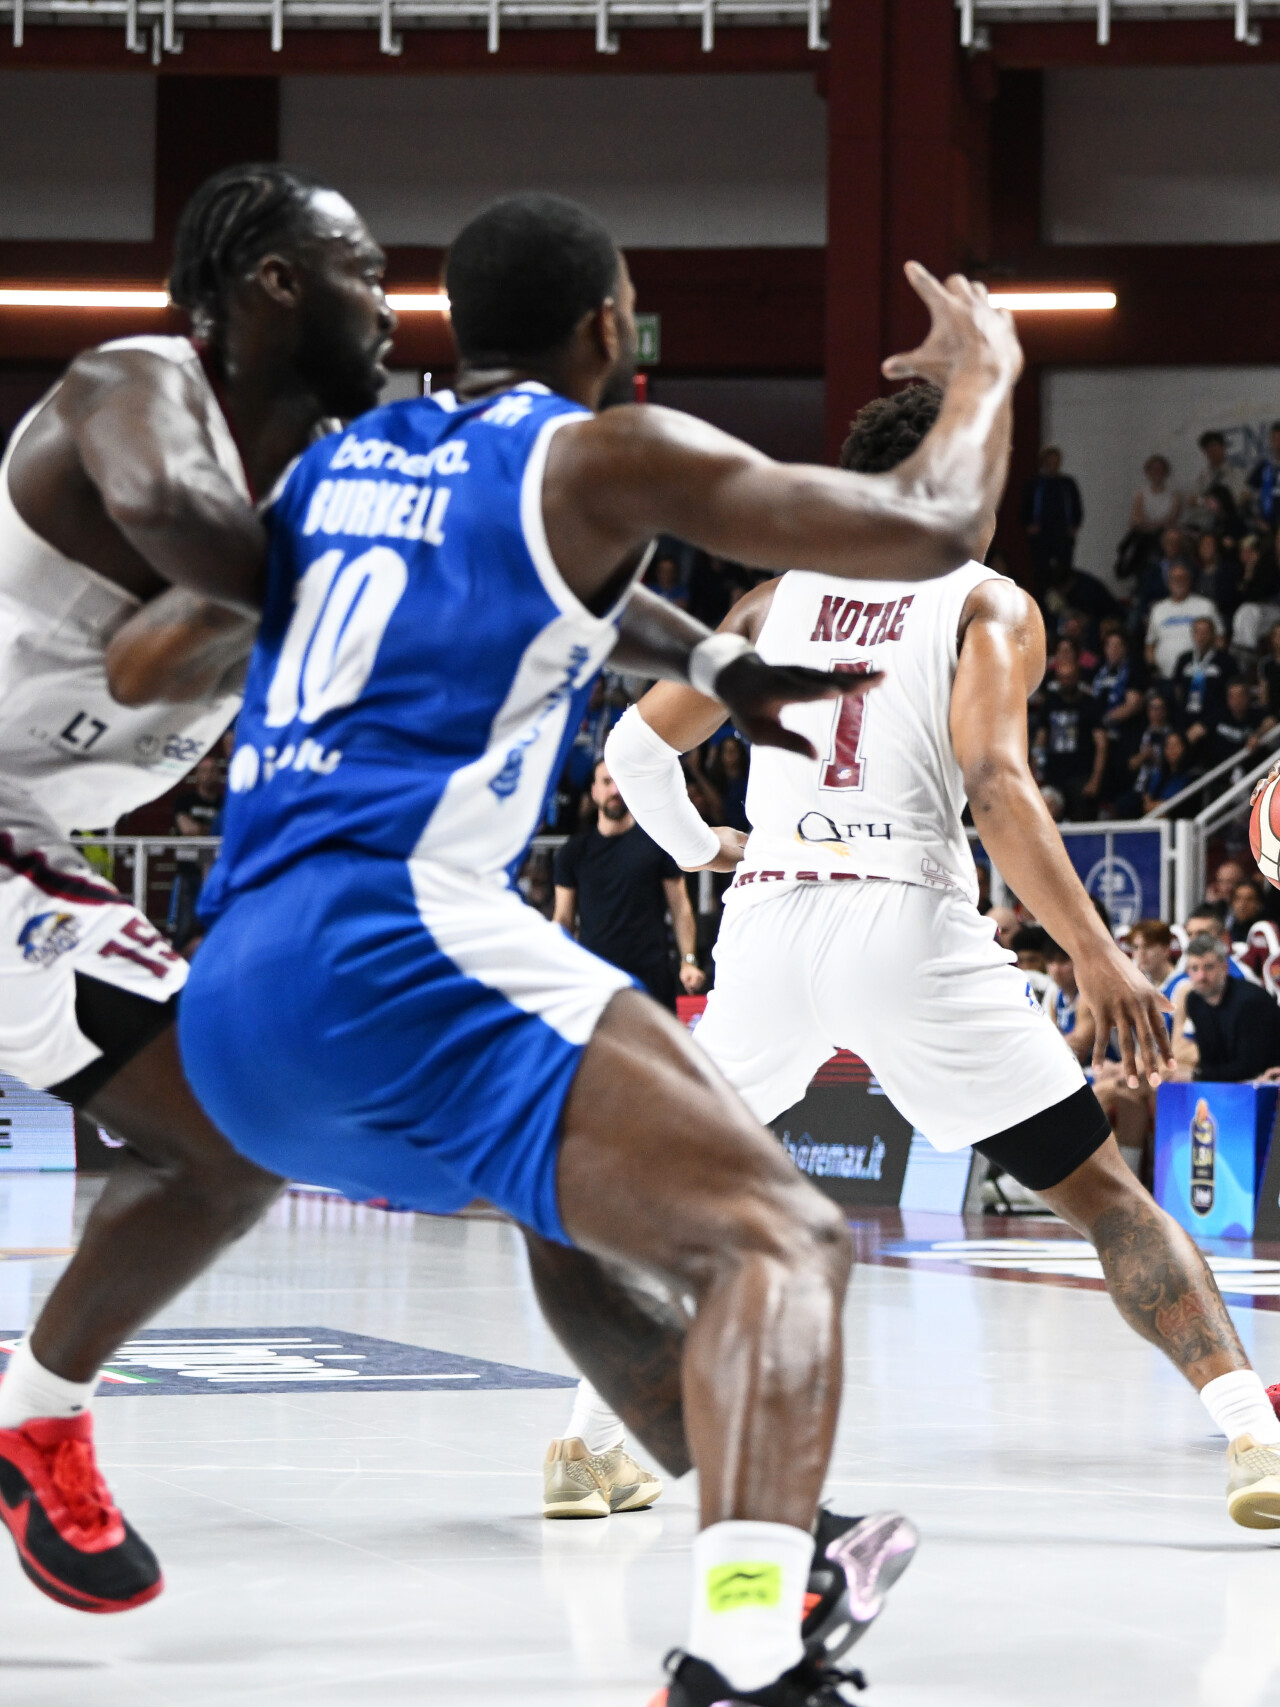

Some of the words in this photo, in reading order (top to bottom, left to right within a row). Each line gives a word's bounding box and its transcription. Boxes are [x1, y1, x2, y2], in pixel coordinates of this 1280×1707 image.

[263, 544, 409, 728] 10
[810, 594, 915, 647] NOTAE
[819, 658, 873, 792] 1
